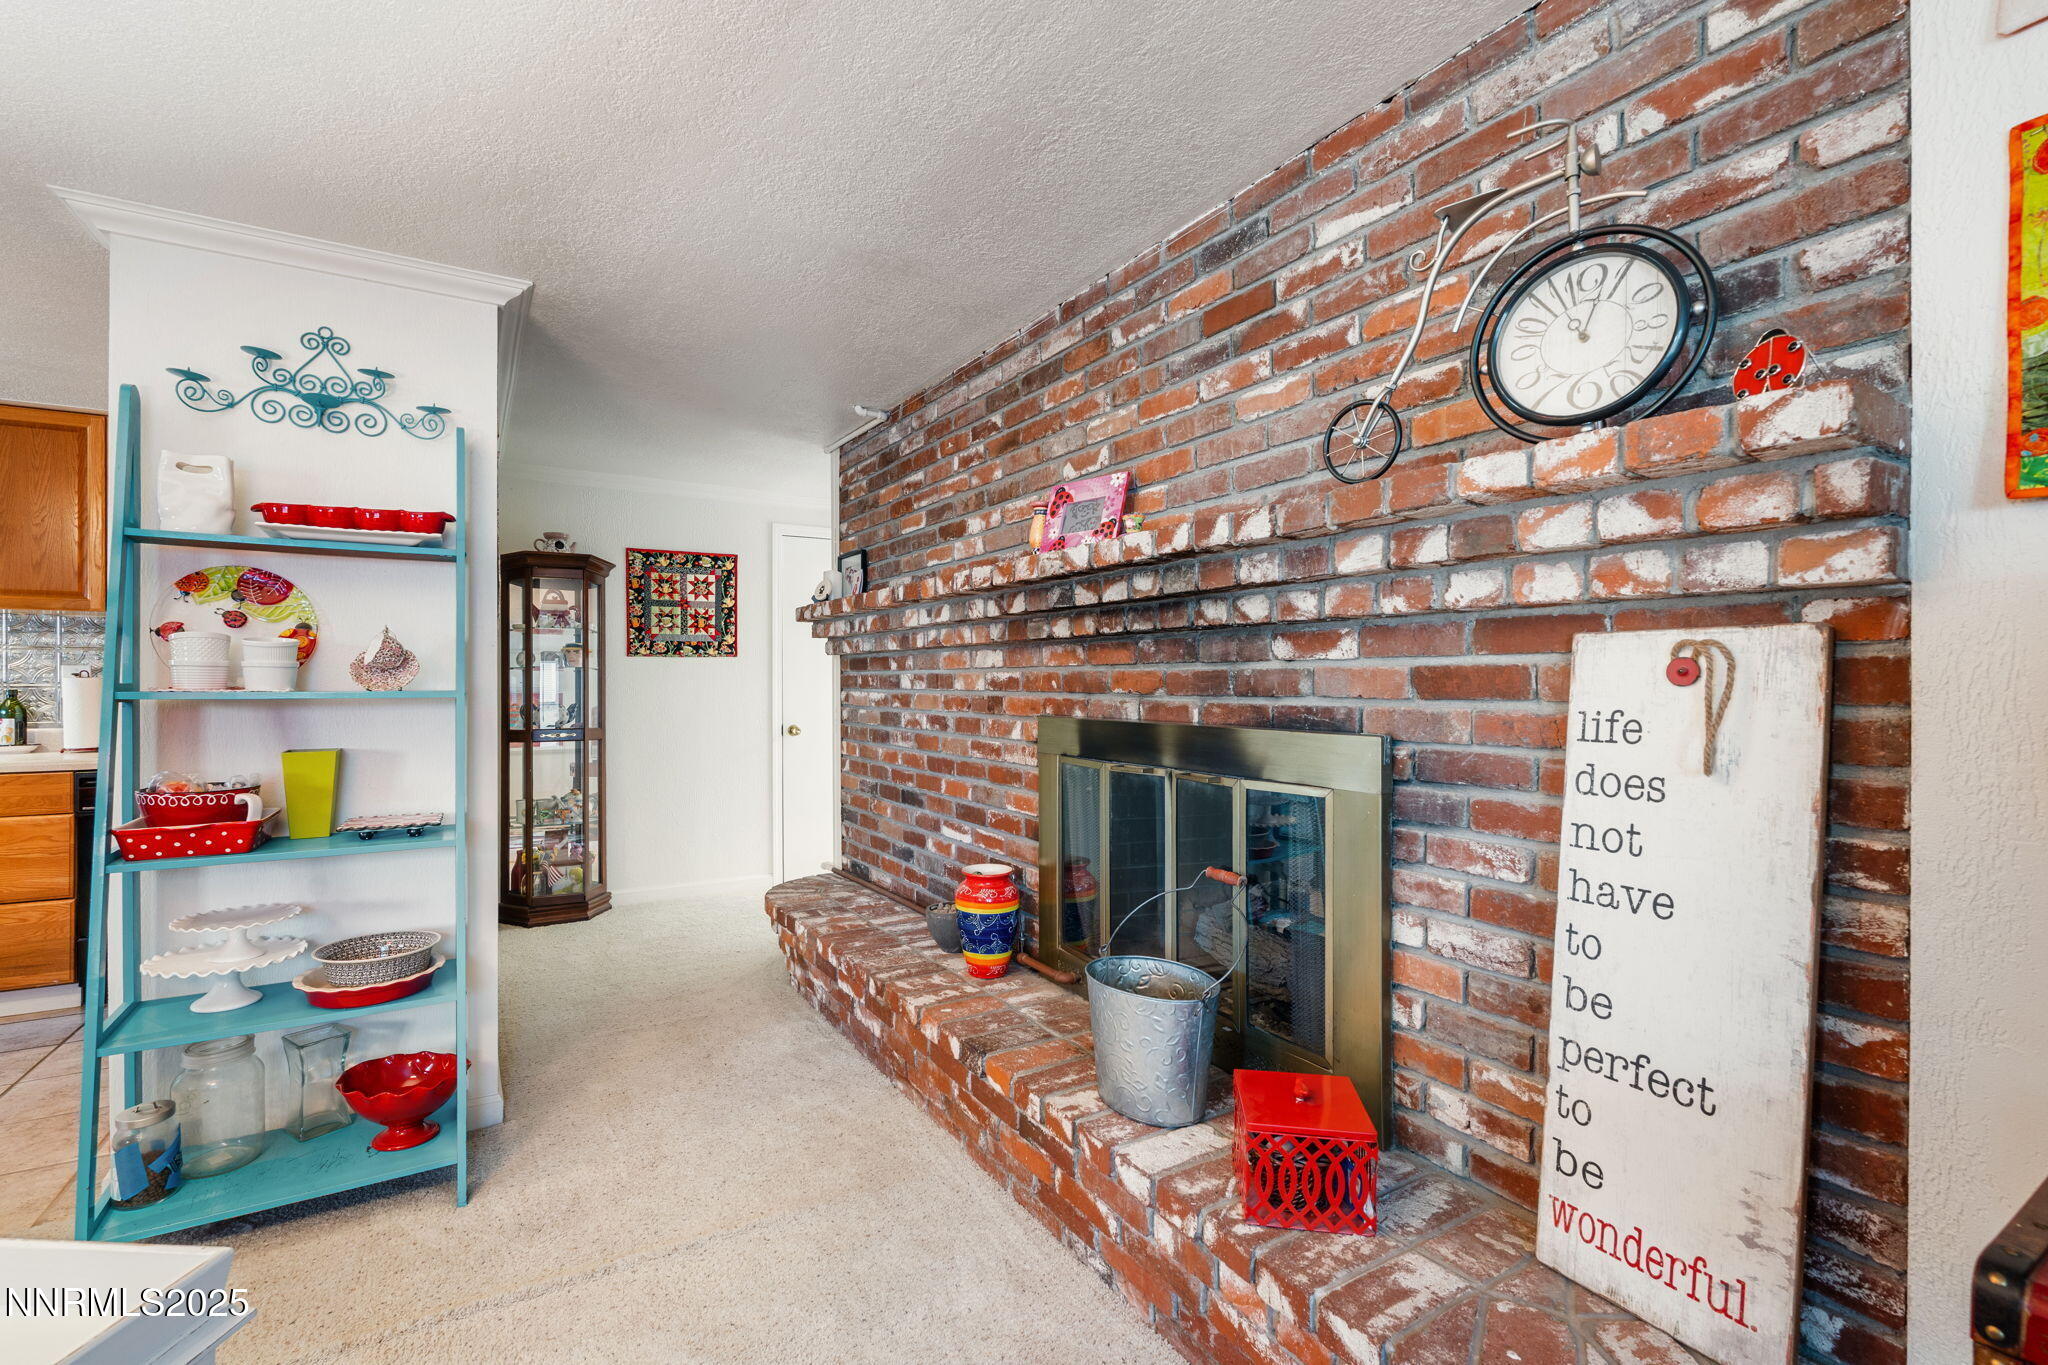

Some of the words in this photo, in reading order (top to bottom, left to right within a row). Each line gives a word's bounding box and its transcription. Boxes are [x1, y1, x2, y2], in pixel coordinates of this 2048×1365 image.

[1528, 278, 1568, 318] 11
[1564, 263, 1608, 306] 12
[1607, 257, 1635, 299] 1
[1566, 373, 1603, 410] 6
[1576, 709, 1643, 745] life
[1575, 763, 1666, 803] does
[1569, 822, 1643, 857] not
[1567, 868, 1675, 920] have
[1565, 922, 1602, 960] to
[1562, 975, 1613, 1020] be
[1556, 1035, 1717, 1117] perfect
[1555, 1084, 1592, 1127] to
[1552, 1136, 1604, 1190] be
[1549, 1193, 1758, 1333] wonderful.
